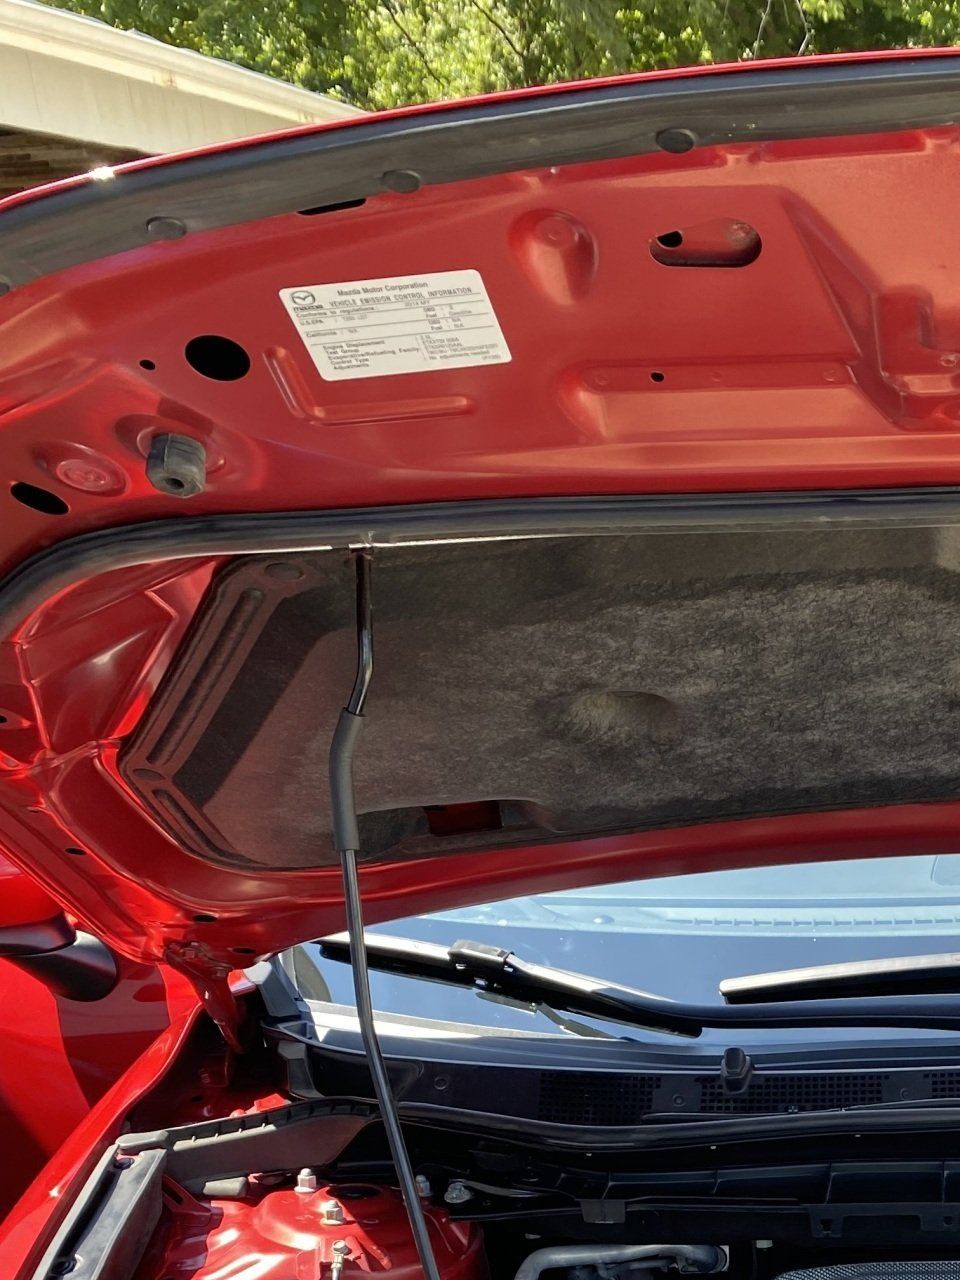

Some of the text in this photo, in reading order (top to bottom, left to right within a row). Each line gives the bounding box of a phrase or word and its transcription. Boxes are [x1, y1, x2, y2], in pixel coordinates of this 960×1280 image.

[329, 286, 473, 307] VEHICLE EMISSION CONTROL INFORMATION
[337, 288, 361, 296] Mazda
[385, 282, 428, 292] Corporation
